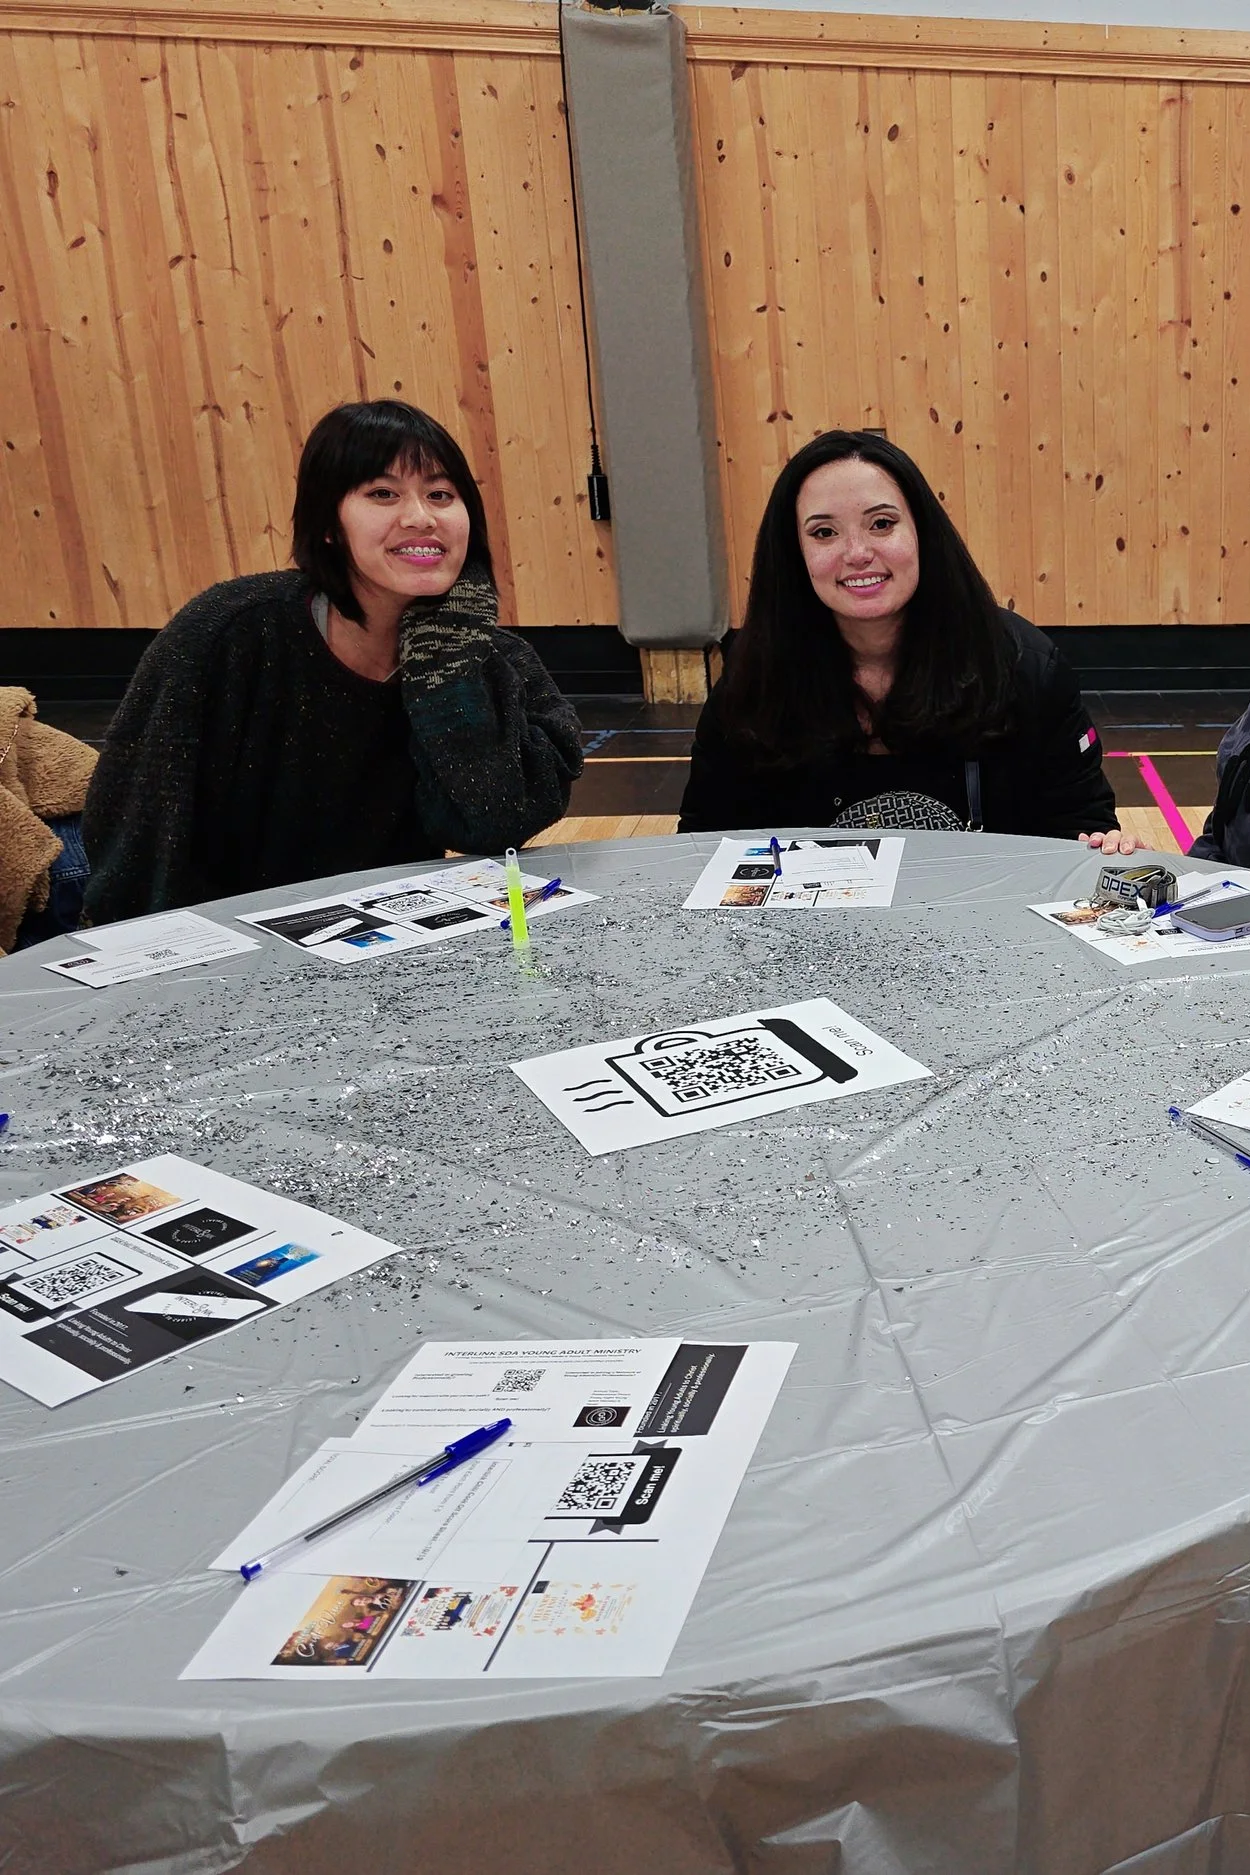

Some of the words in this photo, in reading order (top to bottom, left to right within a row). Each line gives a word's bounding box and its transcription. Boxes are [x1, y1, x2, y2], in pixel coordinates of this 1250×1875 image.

[1101, 875, 1148, 898] OPEX
[822, 1025, 850, 1038] me!
[844, 1038, 874, 1056] Scan
[89, 1308, 112, 1322] Founded
[683, 1365, 698, 1379] Christ
[672, 1384, 688, 1400] Adults
[682, 1389, 698, 1407] socially
[665, 1400, 681, 1414] Young
[656, 1415, 674, 1433] Linking
[634, 1480, 657, 1506] Scan
[650, 1464, 666, 1482] me!
[424, 1596, 451, 1627] PATCH
